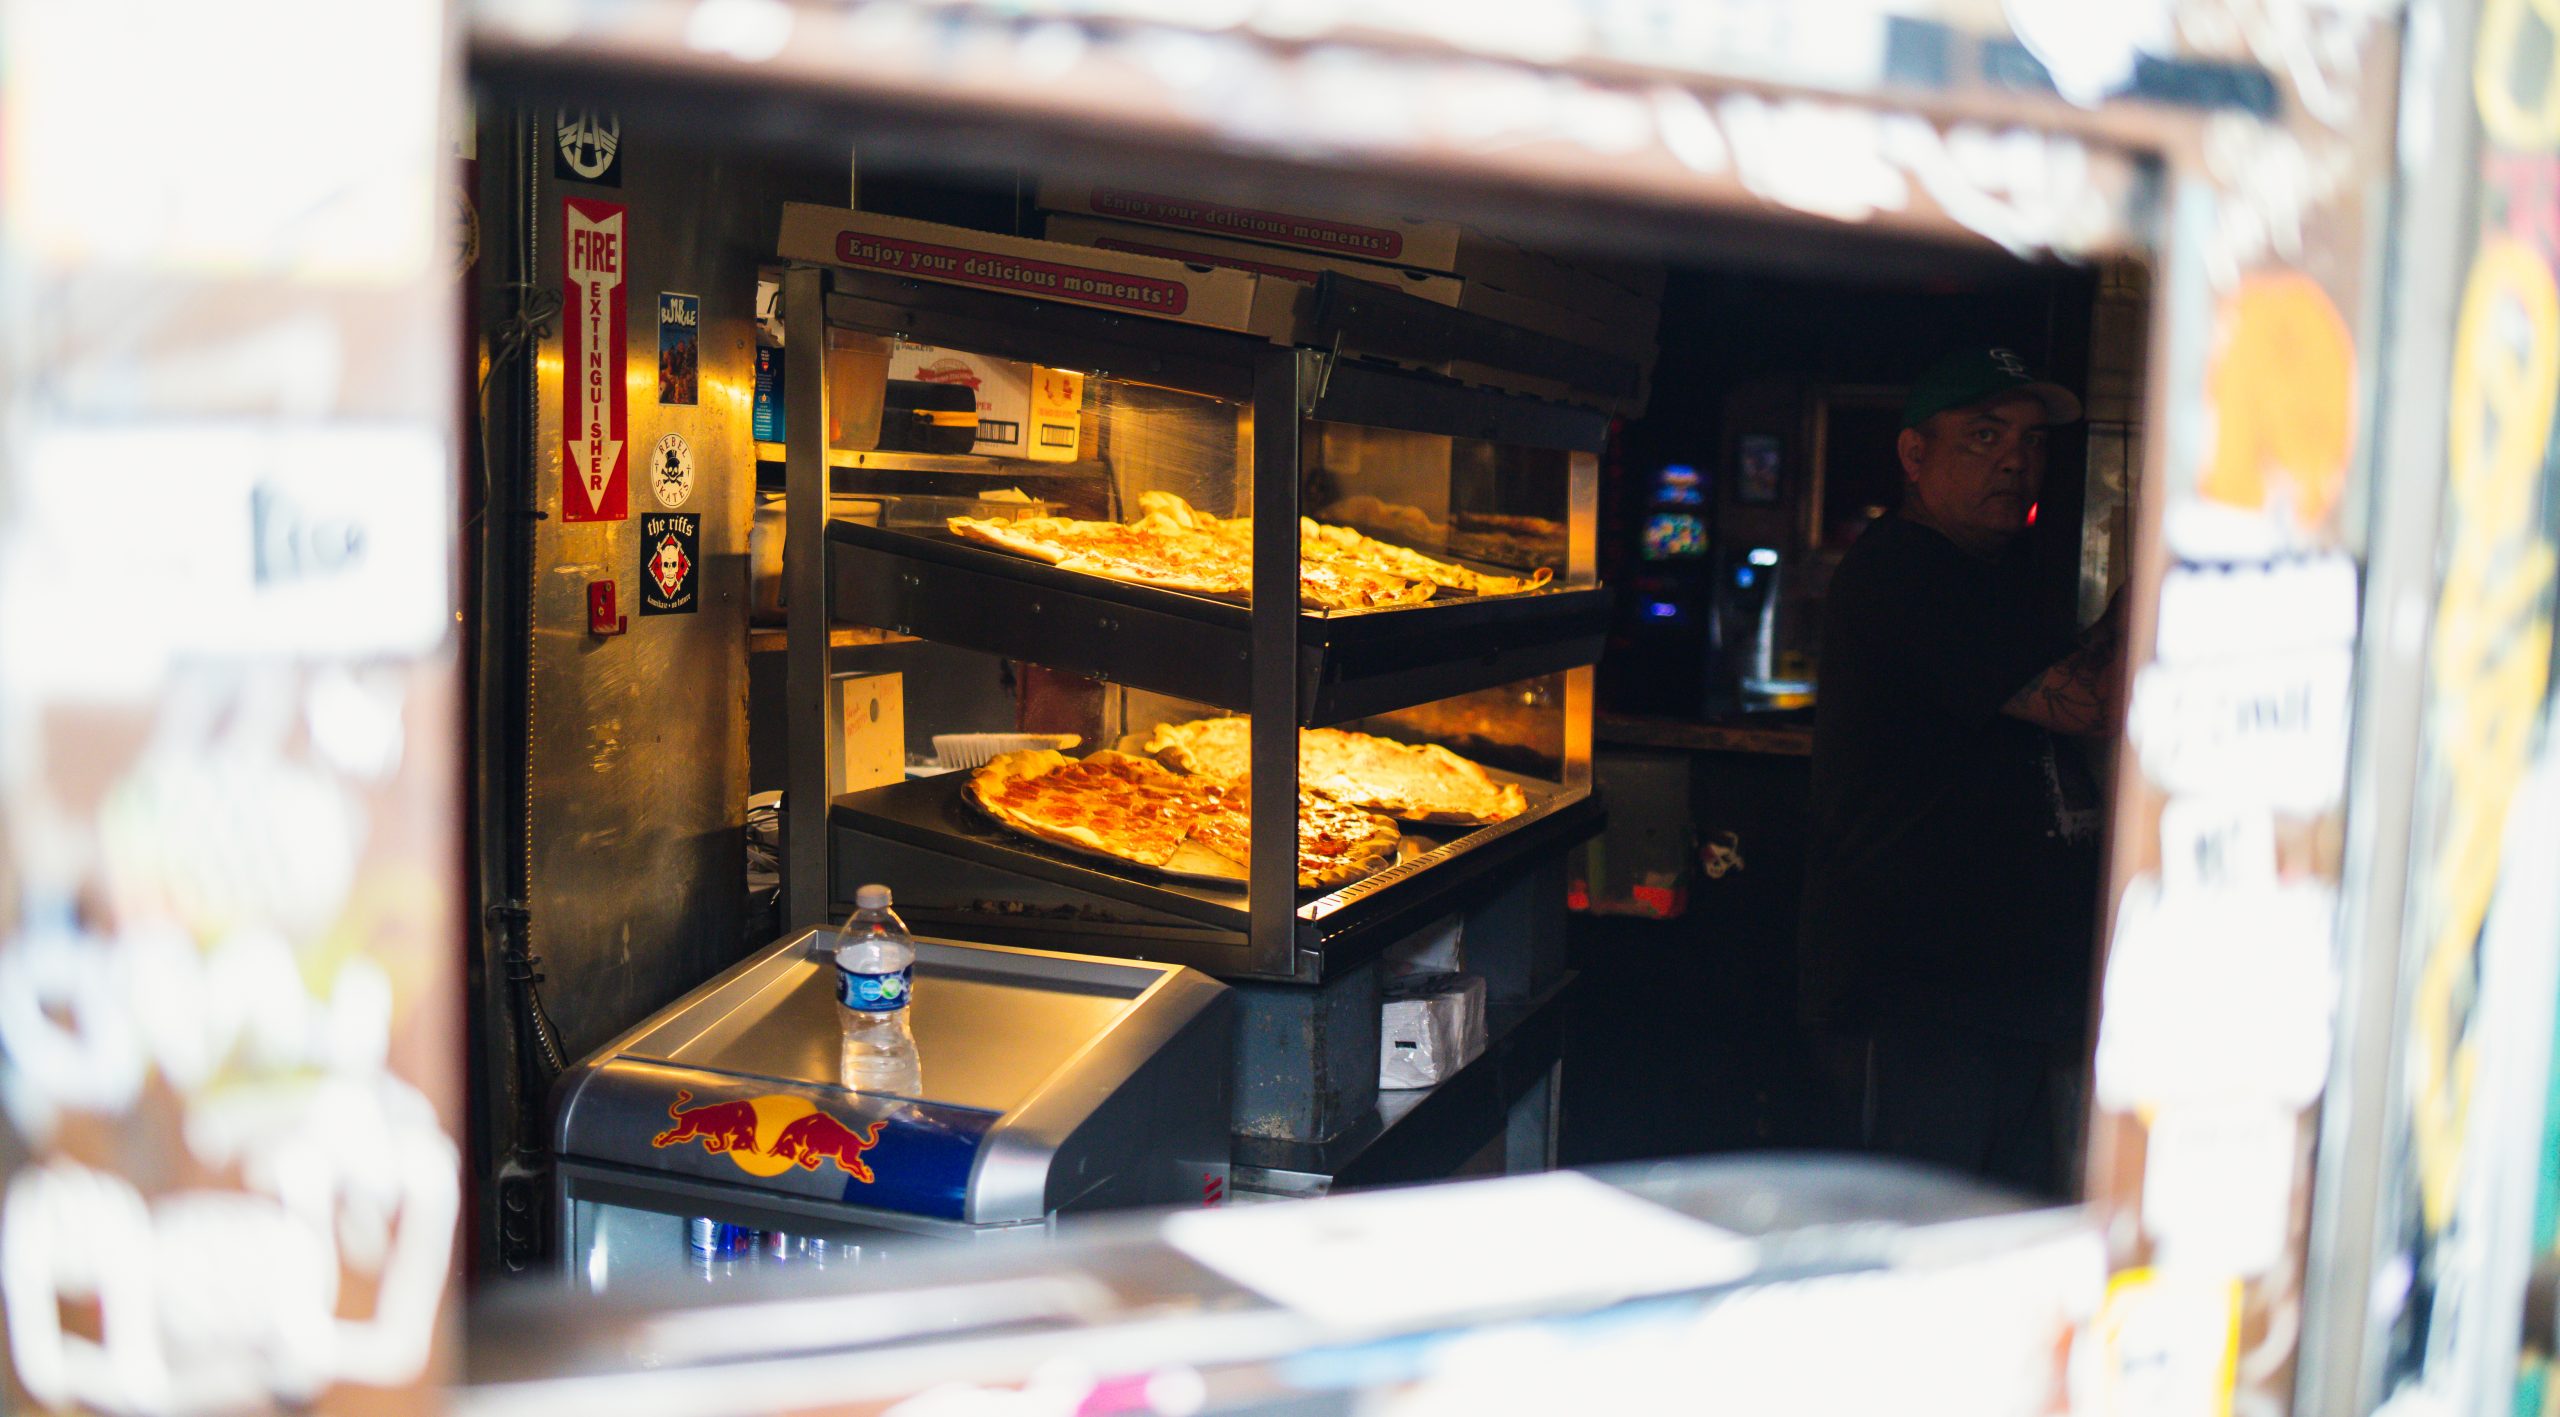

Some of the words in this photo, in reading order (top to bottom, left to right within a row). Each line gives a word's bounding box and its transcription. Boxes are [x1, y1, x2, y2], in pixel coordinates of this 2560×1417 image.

[1157, 204, 1198, 221] your
[1206, 209, 1287, 234] delicious
[574, 229, 617, 273] FIRE
[849, 239, 903, 265] Enjoy
[909, 252, 956, 271] your
[964, 257, 1056, 287] delicious
[589, 281, 602, 491] EXTINGUISHER
[658, 436, 688, 458] REBEL
[656, 479, 688, 503] SKATES
[647, 518, 665, 536] the
[669, 515, 694, 536] riffs
